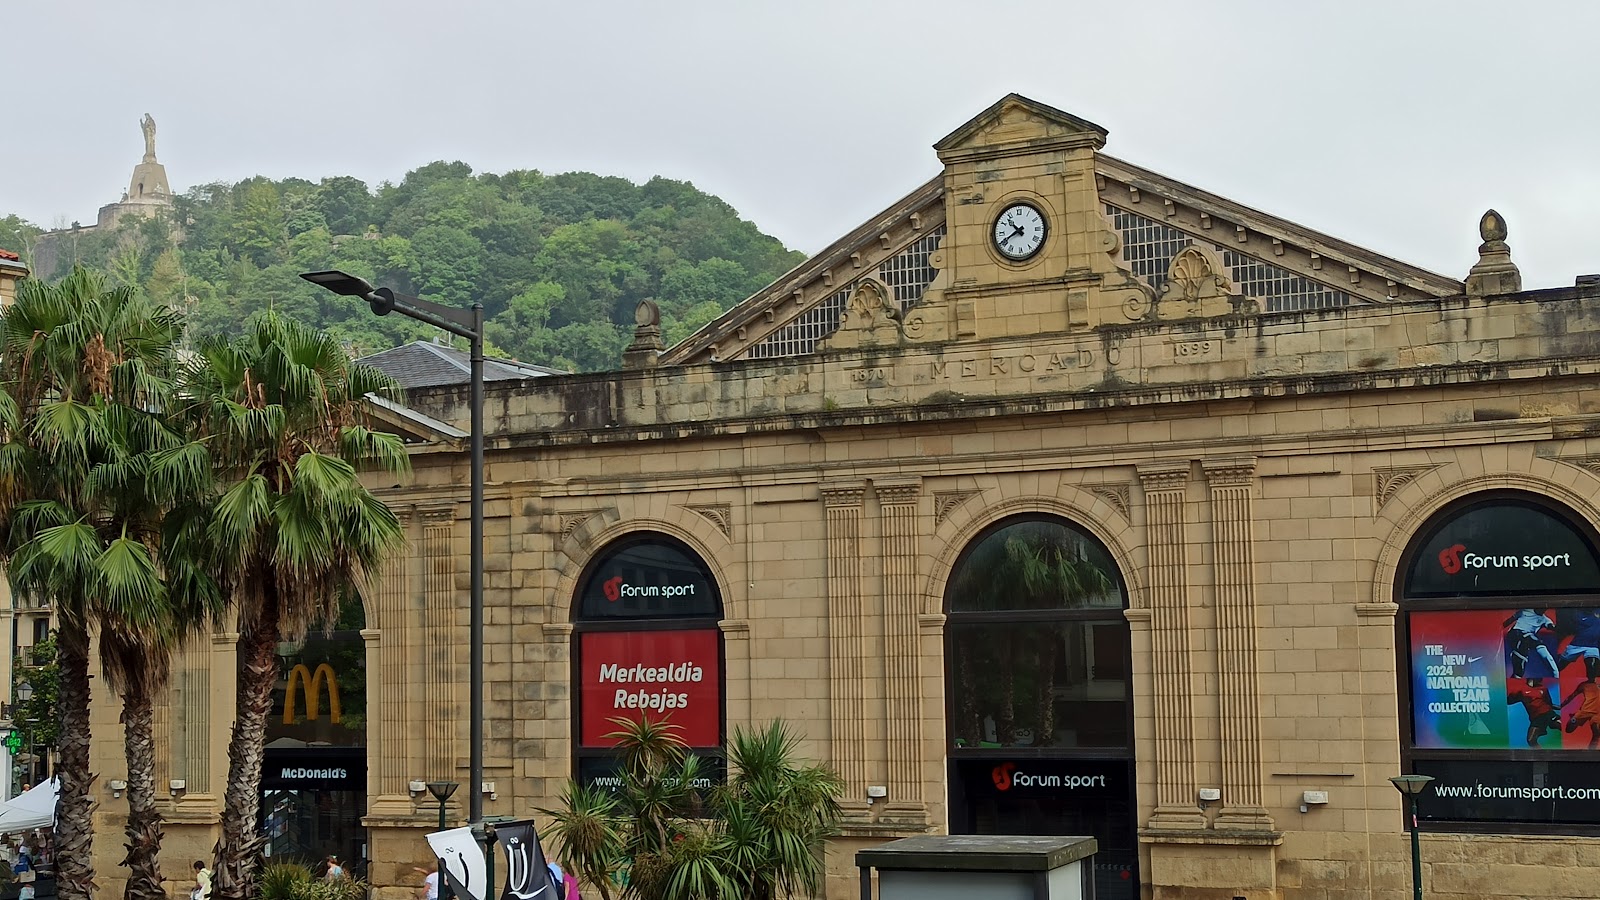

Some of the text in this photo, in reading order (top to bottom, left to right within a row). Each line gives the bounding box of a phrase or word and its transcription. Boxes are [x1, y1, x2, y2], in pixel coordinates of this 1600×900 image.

[1174, 342, 1211, 357] 1899
[930, 345, 1122, 380] MERCADO
[851, 368, 886, 382] 1870
[1522, 552, 1571, 571] sport
[661, 583, 695, 599] sport
[1425, 645, 1444, 656] THE
[1442, 654, 1467, 666] NEW
[599, 661, 703, 683] Merkealdia
[1426, 665, 1453, 676] 2024
[1426, 676, 1489, 690] NATIONAL
[613, 687, 688, 713] Rebajas
[1452, 689, 1490, 702] TEAM
[1428, 702, 1490, 713] COLLECTIONS
[281, 767, 347, 779] McDonald's
[1064, 774, 1105, 790] sport
[1434, 783, 1600, 802] www.forumsport.com
